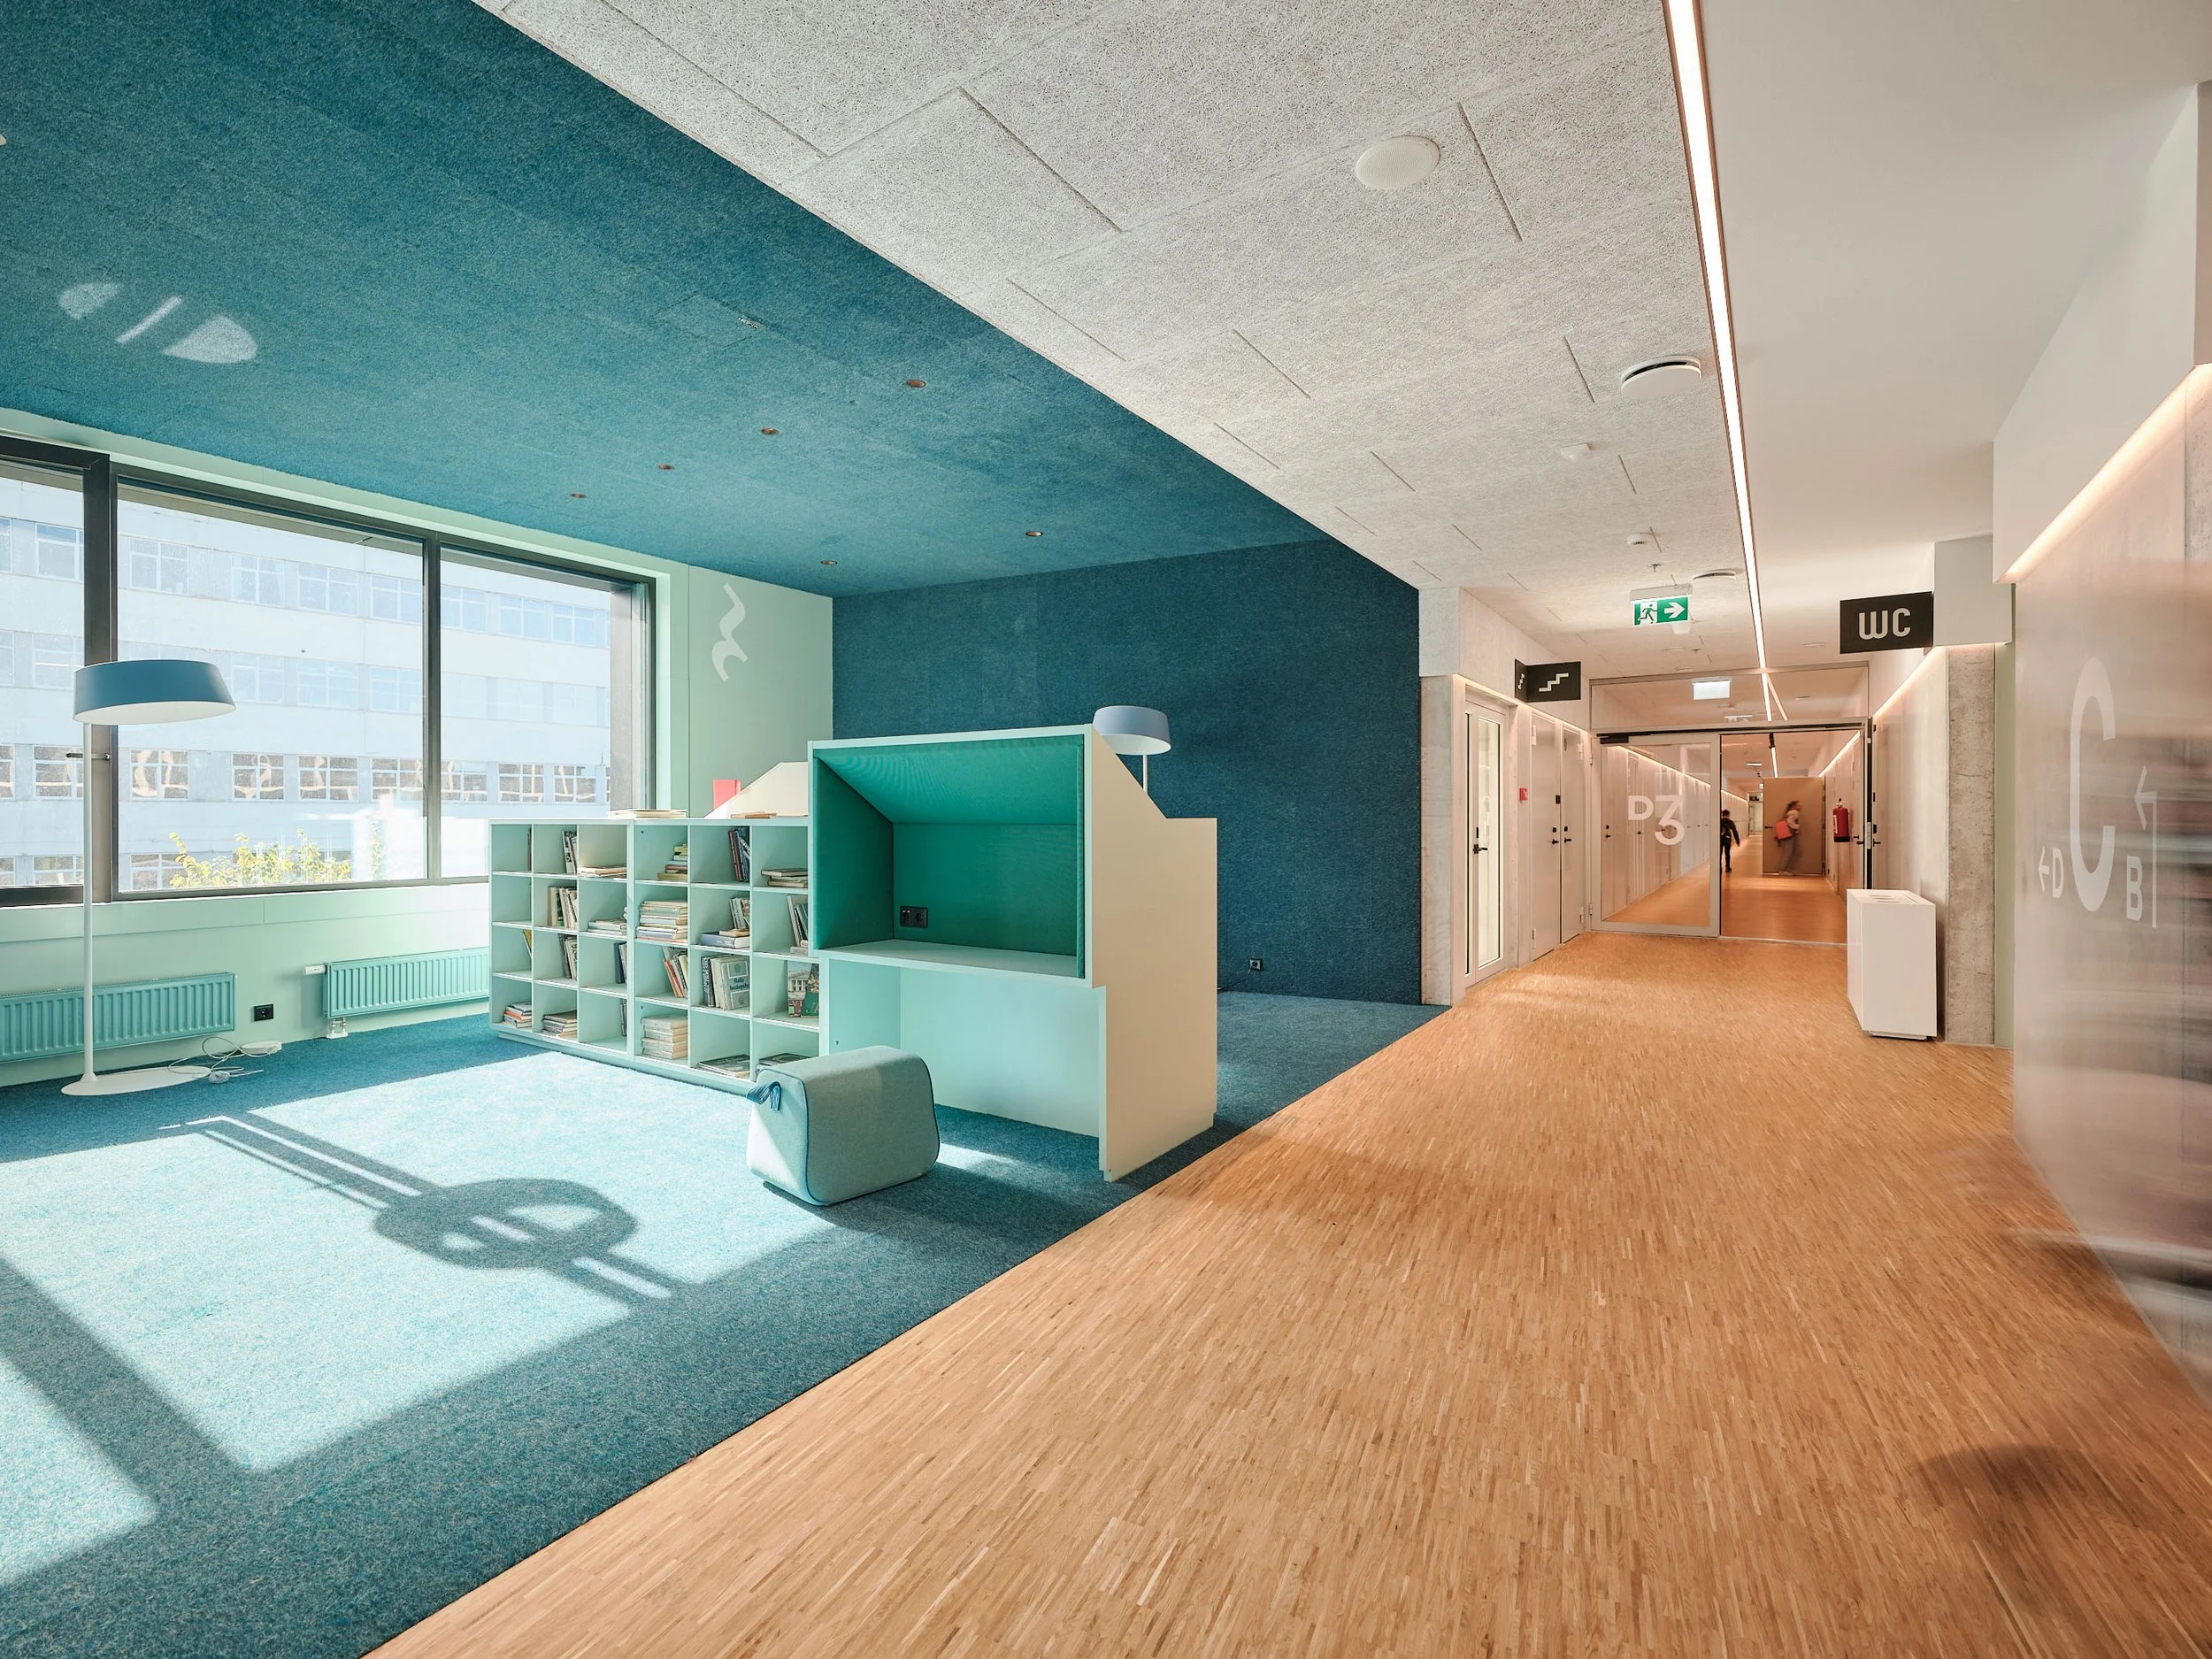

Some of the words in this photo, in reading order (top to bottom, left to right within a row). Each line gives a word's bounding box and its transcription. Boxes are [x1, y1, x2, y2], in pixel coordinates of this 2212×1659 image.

[1858, 607, 1911, 641] WC
[2070, 657, 2116, 912] C
[1628, 795, 1685, 846] D3
[2052, 847, 2064, 899] D
[2126, 855, 2143, 922] B
